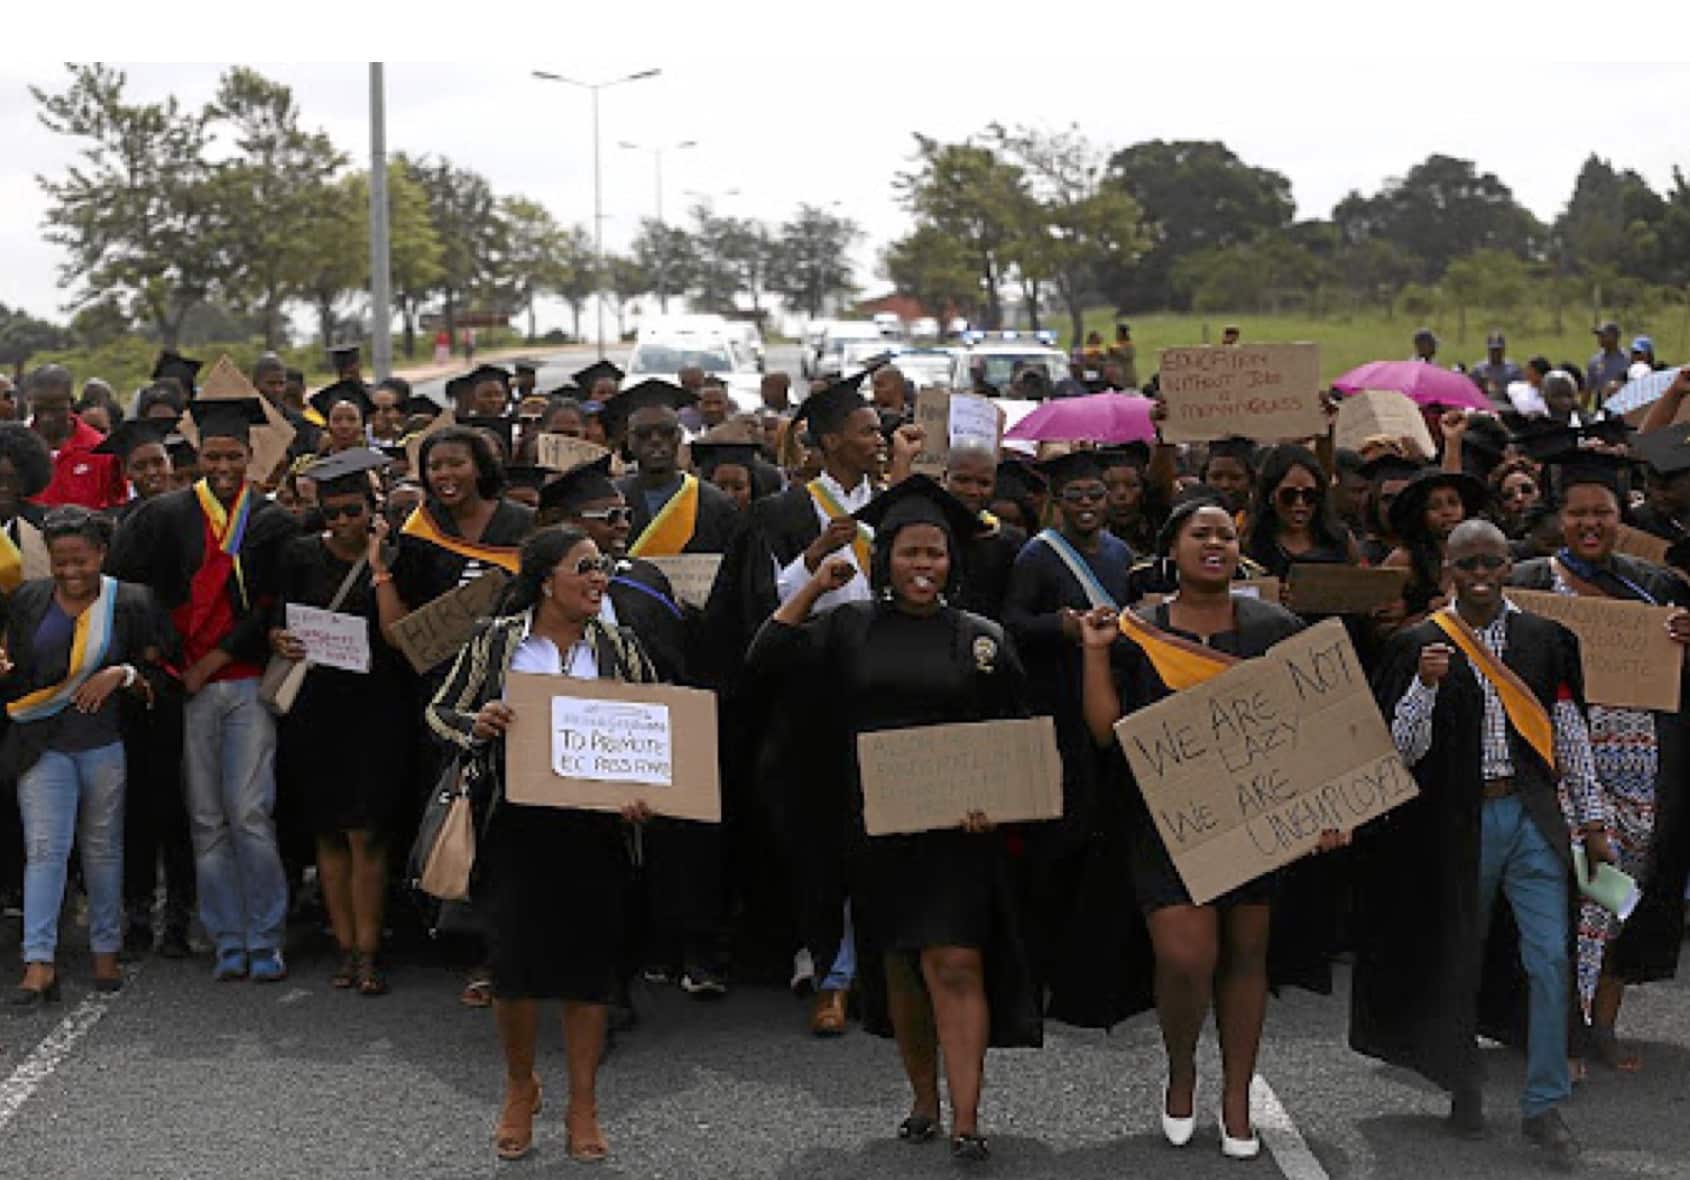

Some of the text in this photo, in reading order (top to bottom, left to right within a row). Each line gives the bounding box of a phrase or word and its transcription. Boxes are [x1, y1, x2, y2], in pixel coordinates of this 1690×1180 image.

[1133, 639, 1354, 776] WE ARE NOT
[557, 728, 667, 757] TO PROMOTE
[1216, 721, 1298, 774] LAZY
[1161, 768, 1297, 842] WE ARE
